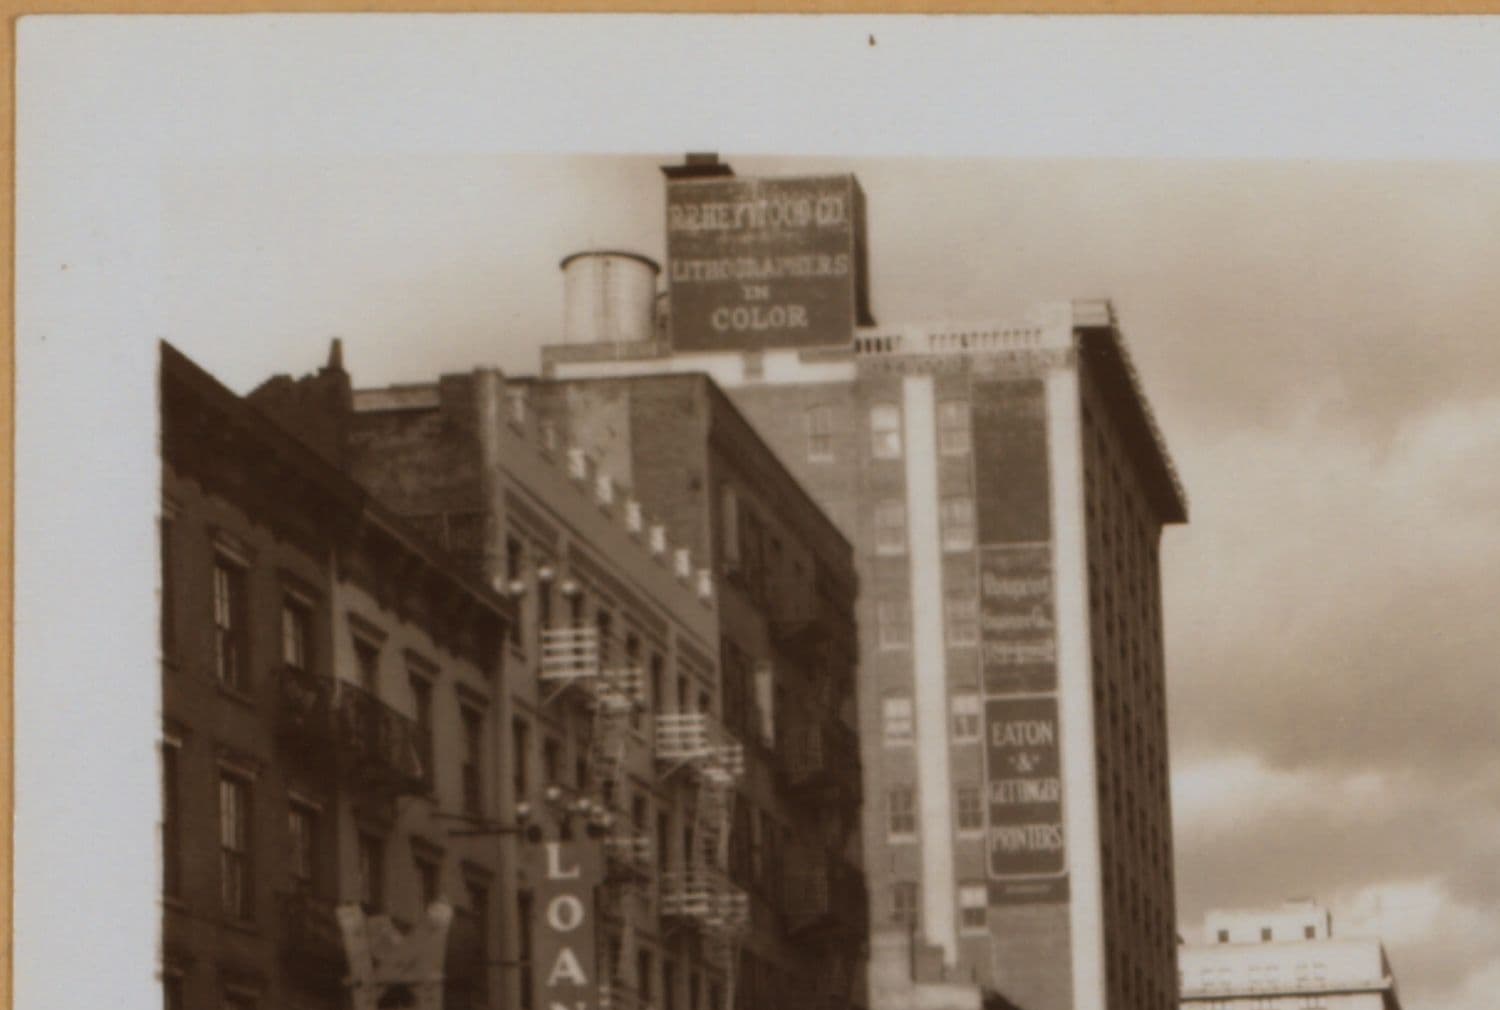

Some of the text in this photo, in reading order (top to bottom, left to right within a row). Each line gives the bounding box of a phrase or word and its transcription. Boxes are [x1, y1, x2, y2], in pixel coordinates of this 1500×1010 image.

[711, 304, 808, 331] COLOR
[992, 720, 1053, 747] EATON
[989, 823, 1062, 851] PRINTERS
